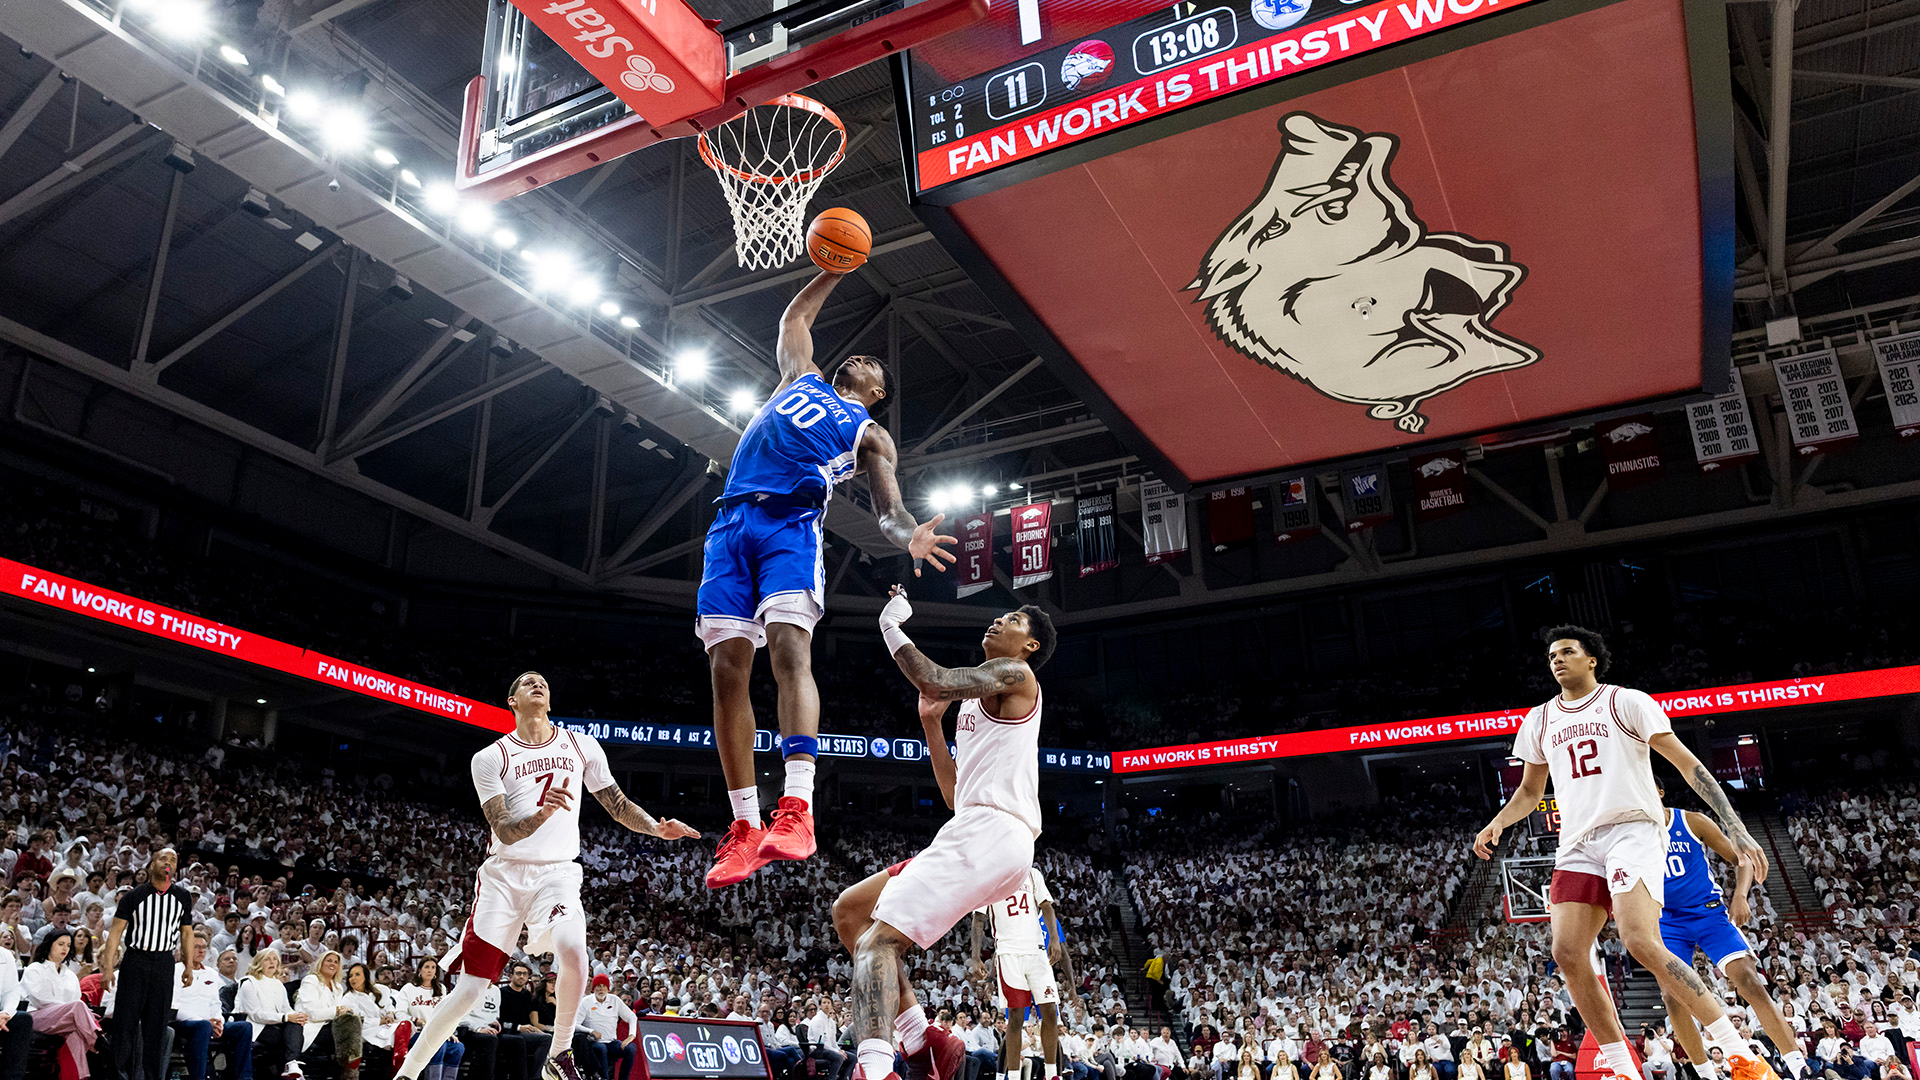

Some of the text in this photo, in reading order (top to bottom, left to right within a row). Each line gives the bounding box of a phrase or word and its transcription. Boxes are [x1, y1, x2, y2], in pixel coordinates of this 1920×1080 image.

[1173, 3, 1181, 20] 1
[1148, 17, 1220, 65] 13:08
[948, 0, 1499, 176] FAN WORK IS THIRSTY WO
[1004, 71, 1028, 109] 11
[930, 103, 963, 125] TOL 2
[931, 122, 965, 145] FLS 0
[818, 244, 852, 265] ELITE
[1879, 344, 1899, 355] NCAA
[1780, 356, 1833, 376] NCAA REGIONAL
[1786, 365, 1832, 382] APPEARANCES
[1888, 367, 1910, 381] 2021
[1788, 380, 1839, 400] 2012 2013
[1890, 379, 1914, 393] 2023
[788, 382, 852, 425] KENTUCKY
[1692, 399, 1742, 419] 2004 2005
[1791, 393, 1842, 412] 2014 2015
[1894, 393, 1918, 407] 2025
[775, 392, 827, 429] 00
[1795, 406, 1844, 425] 2016 2017
[1695, 412, 1744, 431] 2006 2007
[1799, 420, 1849, 439] 2018 2019
[1698, 425, 1748, 443] 2008 2009
[1701, 438, 1750, 457] 2010 2011
[1608, 455, 1660, 474] GYMNASTICS
[1078, 493, 1113, 508] CONFERENCE
[1144, 486, 1160, 497] SWEET
[1428, 487, 1453, 499] WOMEN'S
[1147, 501, 1161, 512] 1990
[1354, 496, 1382, 515] 1999
[1420, 492, 1465, 511] BASKETBALL
[1282, 509, 1309, 528] 1998
[1016, 528, 1047, 543] DEHORNEY
[965, 539, 985, 552] FISCUS
[1022, 544, 1043, 572] 50
[970, 555, 981, 581] 5
[21, 574, 242, 650] FAN WORK IS THIRSTY
[317, 661, 473, 718] FAN WORK IS THIRSTY
[1655, 682, 1825, 712] WORK IS THIRSTY
[588, 723, 610, 739] 20.0
[614, 726, 629, 738] FT%
[631, 725, 653, 742] 66.7
[658, 729, 670, 740] REB
[673, 728, 681, 744] 4
[688, 731, 700, 742] AST
[703, 730, 711, 745] 2
[1350, 730, 1381, 744] FAN
[1384, 724, 1435, 740] WORK
[1437, 722, 1453, 735] IS
[1551, 722, 1609, 748] RAZORBACKS
[833, 740, 864, 755] STATS
[902, 742, 914, 757] 18
[1122, 740, 1279, 768] FAN WORK IS THIRSTY
[515, 757, 574, 780] RAZORBACKS
[1046, 752, 1110, 770] REB 6 AST 2 TO 0
[1567, 739, 1602, 779] 12
[535, 773, 554, 807] 7
[1005, 893, 1029, 917] 24
[697, 1026, 704, 1041] 1
[650, 1040, 661, 1058] 11
[692, 1047, 719, 1068] 13:07
